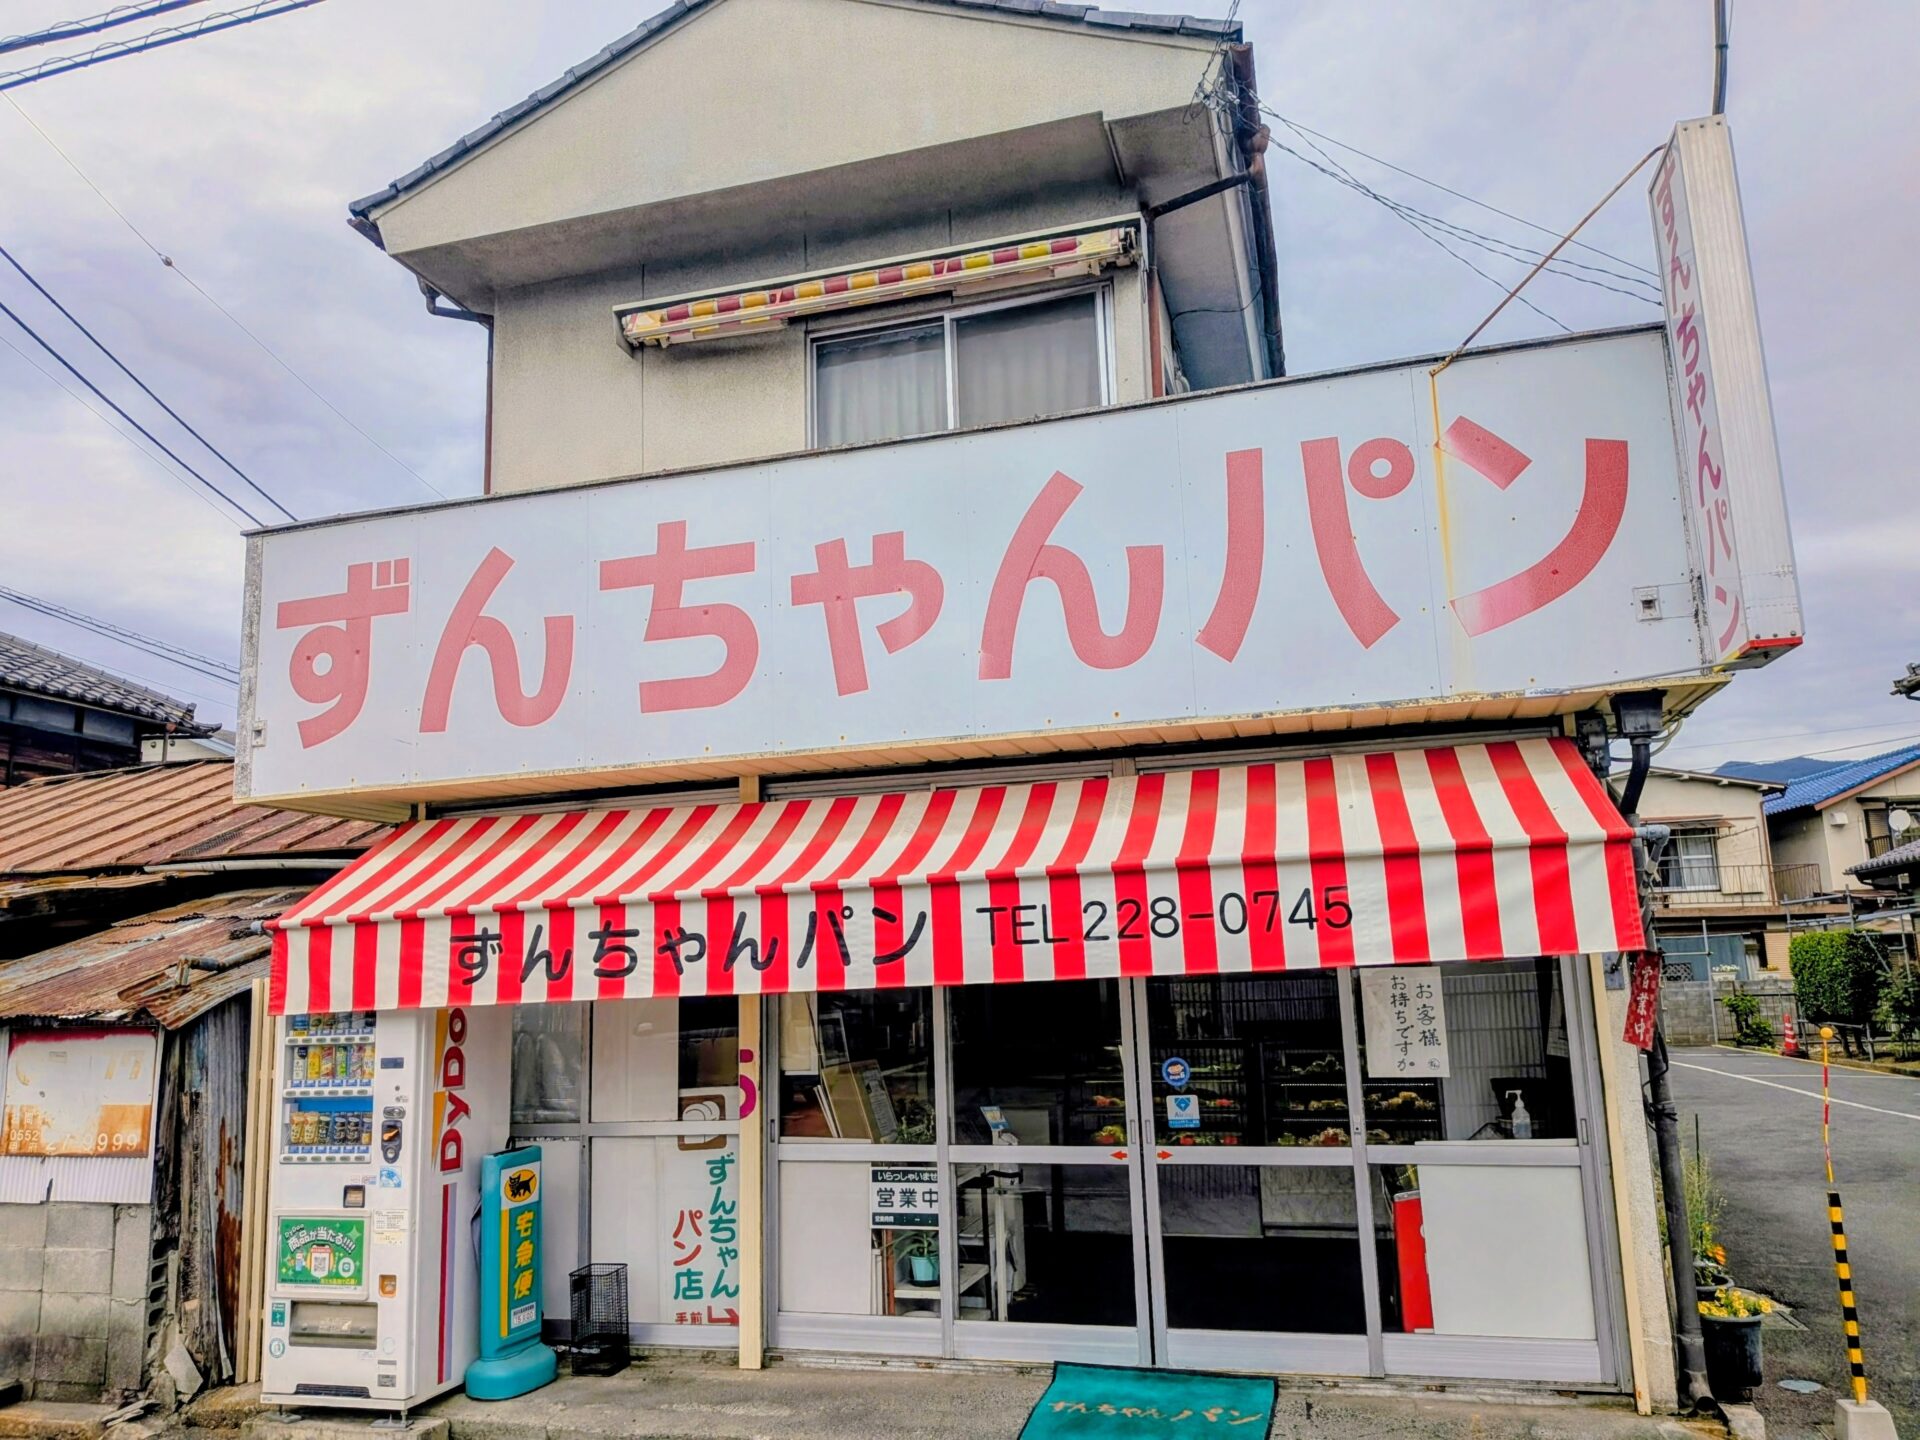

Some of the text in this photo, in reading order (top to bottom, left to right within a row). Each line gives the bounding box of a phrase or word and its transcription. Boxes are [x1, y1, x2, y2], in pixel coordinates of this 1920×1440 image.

[277, 414, 1629, 748] ずんちゃんパン
[450, 905, 927, 985] ずんちゃんパン
[976, 886, 1353, 947] TEL 228-0745
[1416, 983, 1441, 1047] お客様
[1634, 965, 1653, 1042] 営業中
[706, 1152, 739, 1298] ずんちゃん
[876, 1187, 938, 1209] 営業中
[514, 1210, 534, 1300] 宅急便
[672, 1209, 704, 1300] パン店
[675, 1312, 703, 1326] 手前
